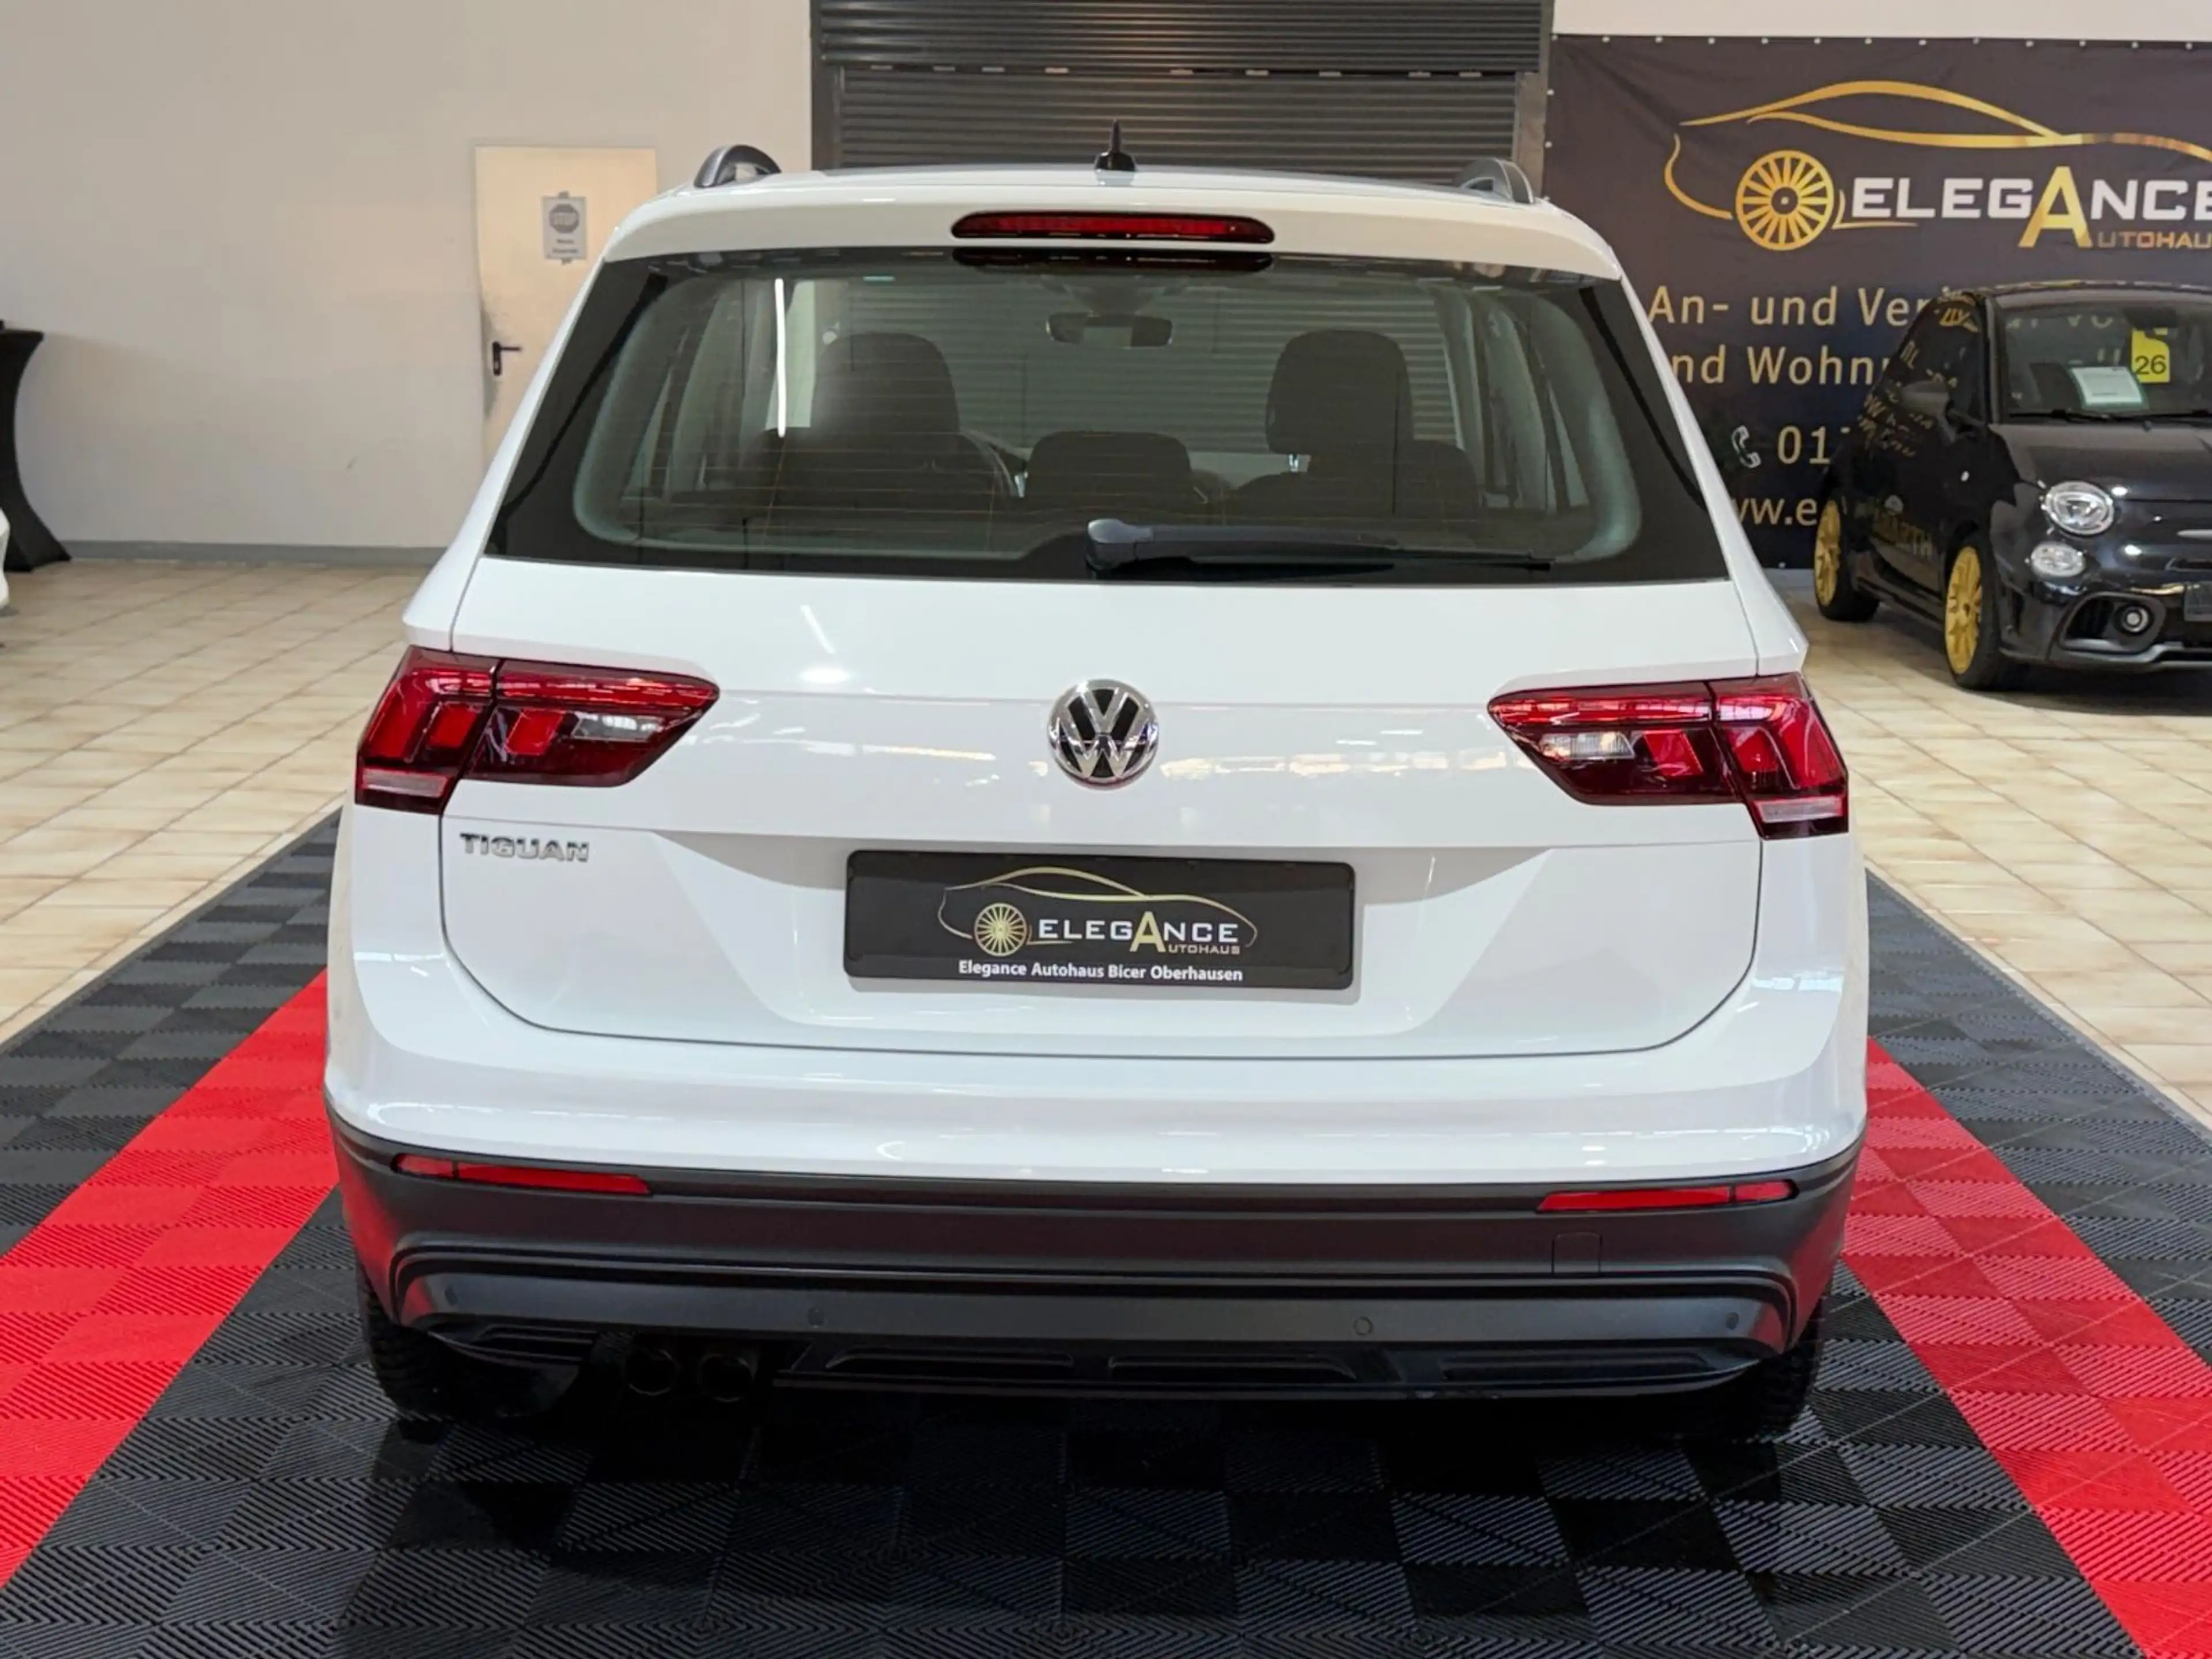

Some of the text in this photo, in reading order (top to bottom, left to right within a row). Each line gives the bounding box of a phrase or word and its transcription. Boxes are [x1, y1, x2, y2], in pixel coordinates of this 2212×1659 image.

[1649, 286, 1729, 324] An-
[1751, 286, 1838, 326] und
[1672, 344, 1890, 385] nd Wohn
[2134, 354, 2167, 375] 26
[1778, 425, 1851, 464] 01
[460, 832, 589, 862] TIGUAN
[1039, 911, 1238, 952] ELEGANCE
[959, 960, 1243, 981] Elegance Autohaus Bicer Oberhausen
